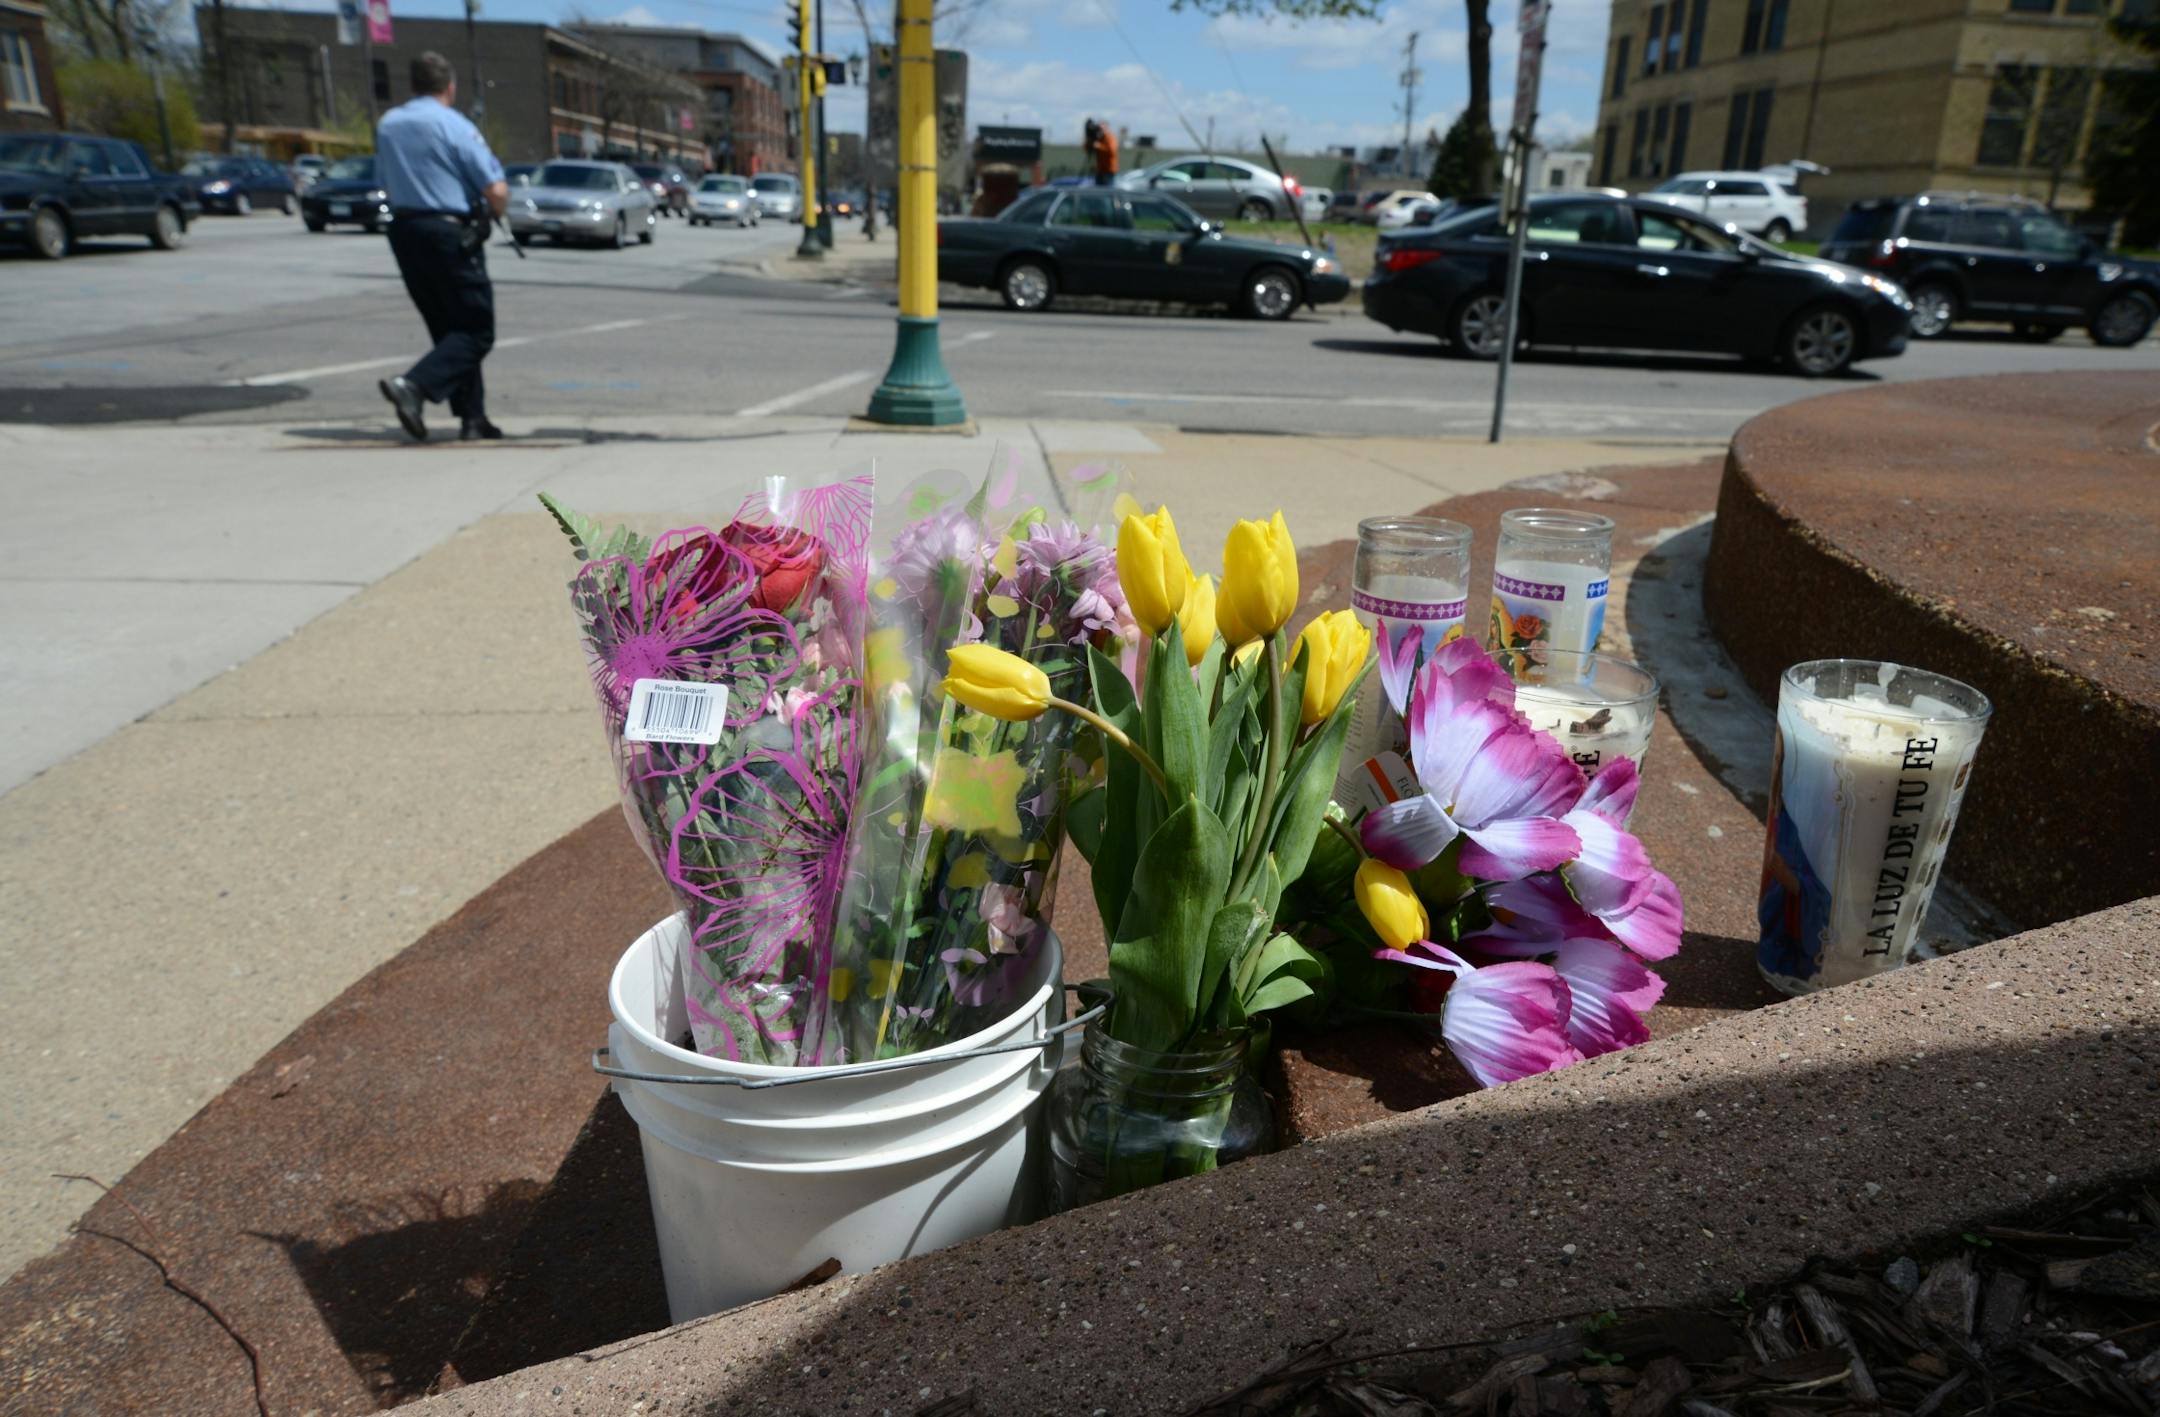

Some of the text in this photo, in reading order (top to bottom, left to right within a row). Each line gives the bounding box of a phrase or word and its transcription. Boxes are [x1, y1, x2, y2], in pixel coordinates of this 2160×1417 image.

[654, 683, 707, 695] Rose Bouquet
[665, 734, 695, 742] Flowers
[1862, 737, 1938, 957] LA LUZ DE TU FE
